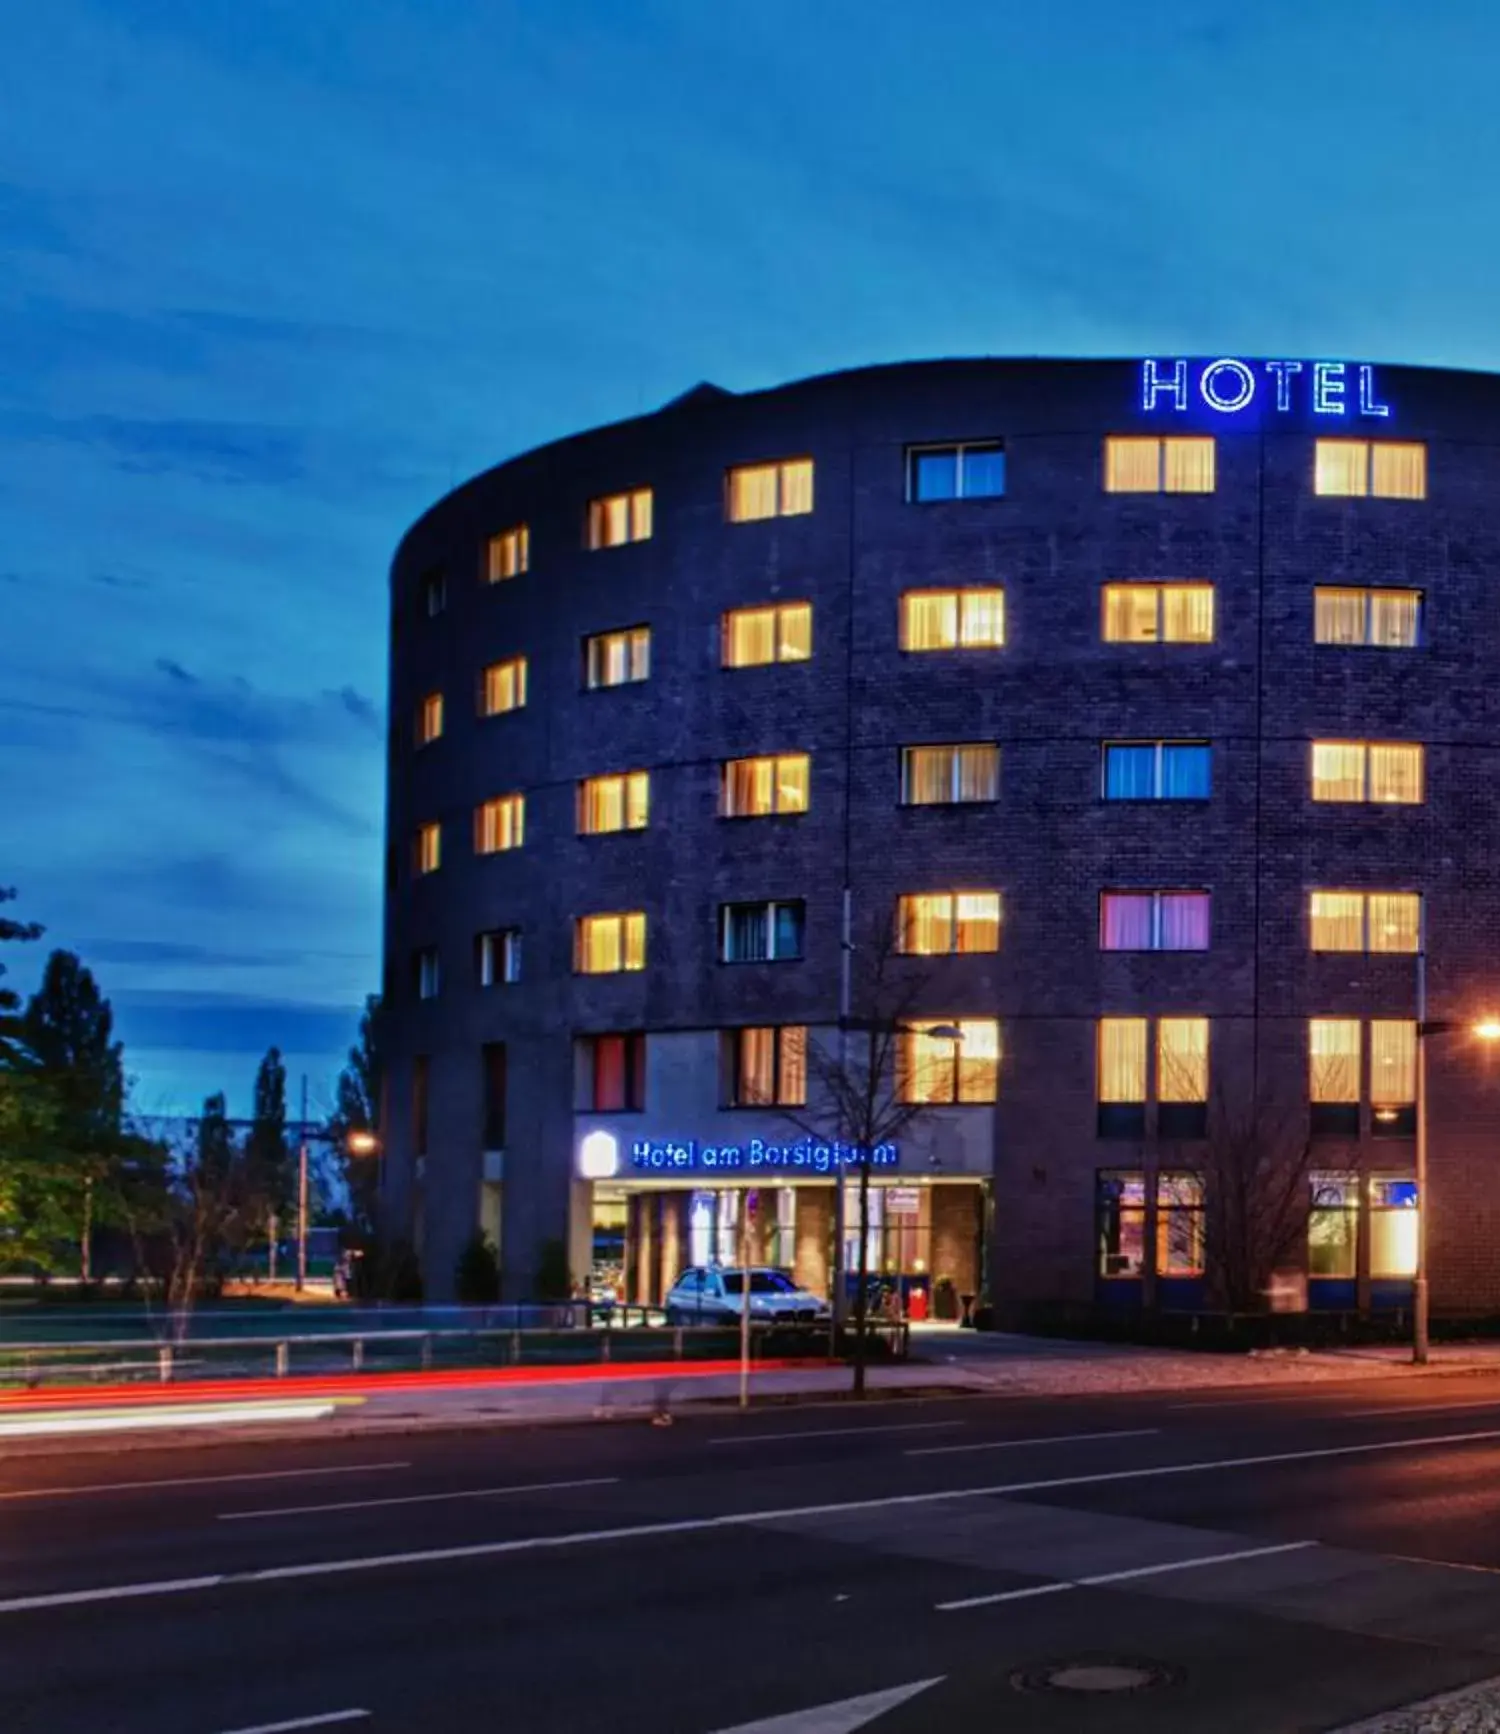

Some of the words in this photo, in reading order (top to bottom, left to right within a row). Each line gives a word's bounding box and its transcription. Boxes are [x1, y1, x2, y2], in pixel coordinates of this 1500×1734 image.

[1142, 358, 1390, 417] HOTEL
[633, 1141, 695, 1167] Hotel
[702, 1147, 740, 1166] am
[750, 1137, 897, 1171] Borsigtum
